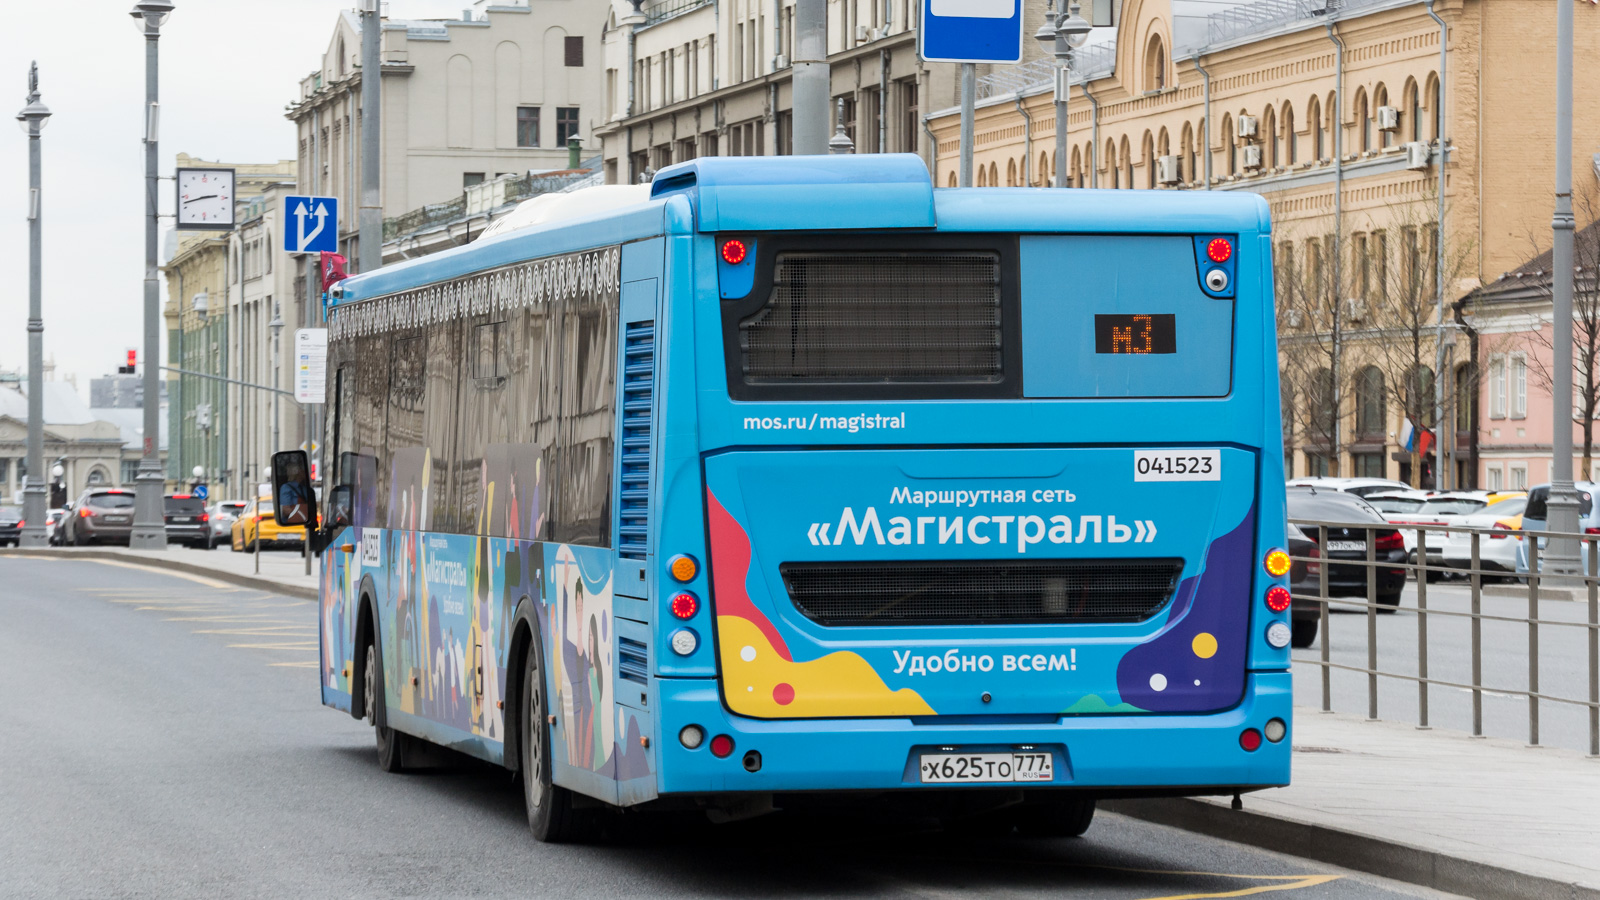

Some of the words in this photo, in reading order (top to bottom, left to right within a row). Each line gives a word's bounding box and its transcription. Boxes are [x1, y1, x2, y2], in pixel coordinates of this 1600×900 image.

[743, 412, 906, 433] mos.ru/magistral
[1137, 456, 1213, 474] 041523
[889, 486, 1027, 508] Маршрутная
[1031, 489, 1077, 503] сеть
[807, 506, 1158, 553] «Магистраль»
[892, 648, 994, 676] Удобно
[1002, 648, 1077, 672] всем!
[1014, 755, 1047, 772] 777
